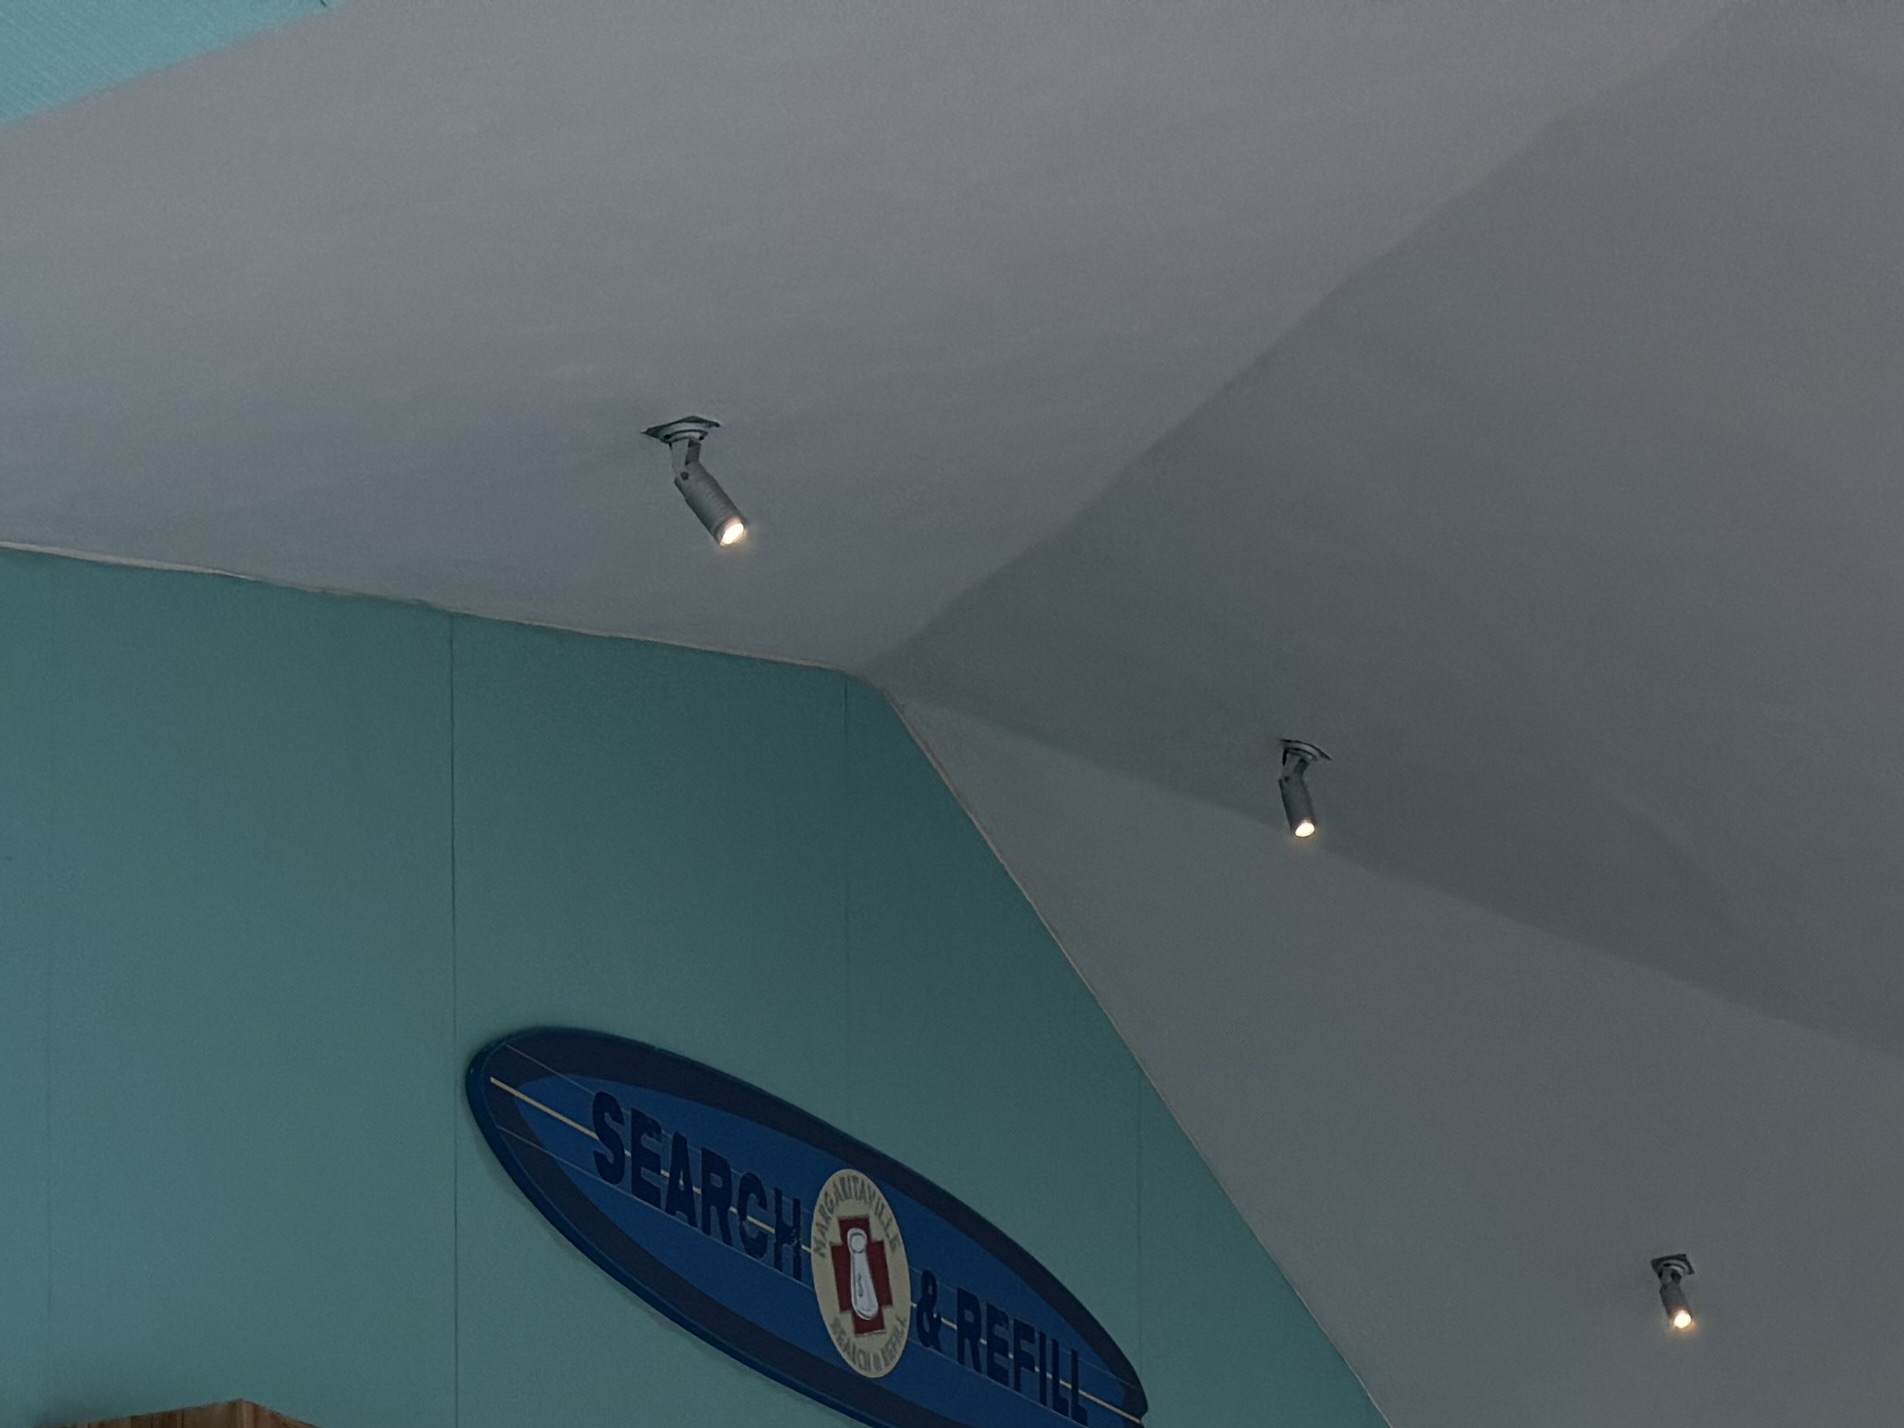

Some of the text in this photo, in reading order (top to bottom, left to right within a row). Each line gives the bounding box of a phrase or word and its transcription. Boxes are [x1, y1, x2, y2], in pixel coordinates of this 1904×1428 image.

[592, 1091, 1089, 1427] SEARCH & REFILL
[818, 1174, 902, 1259] MARGARITAVILLE
